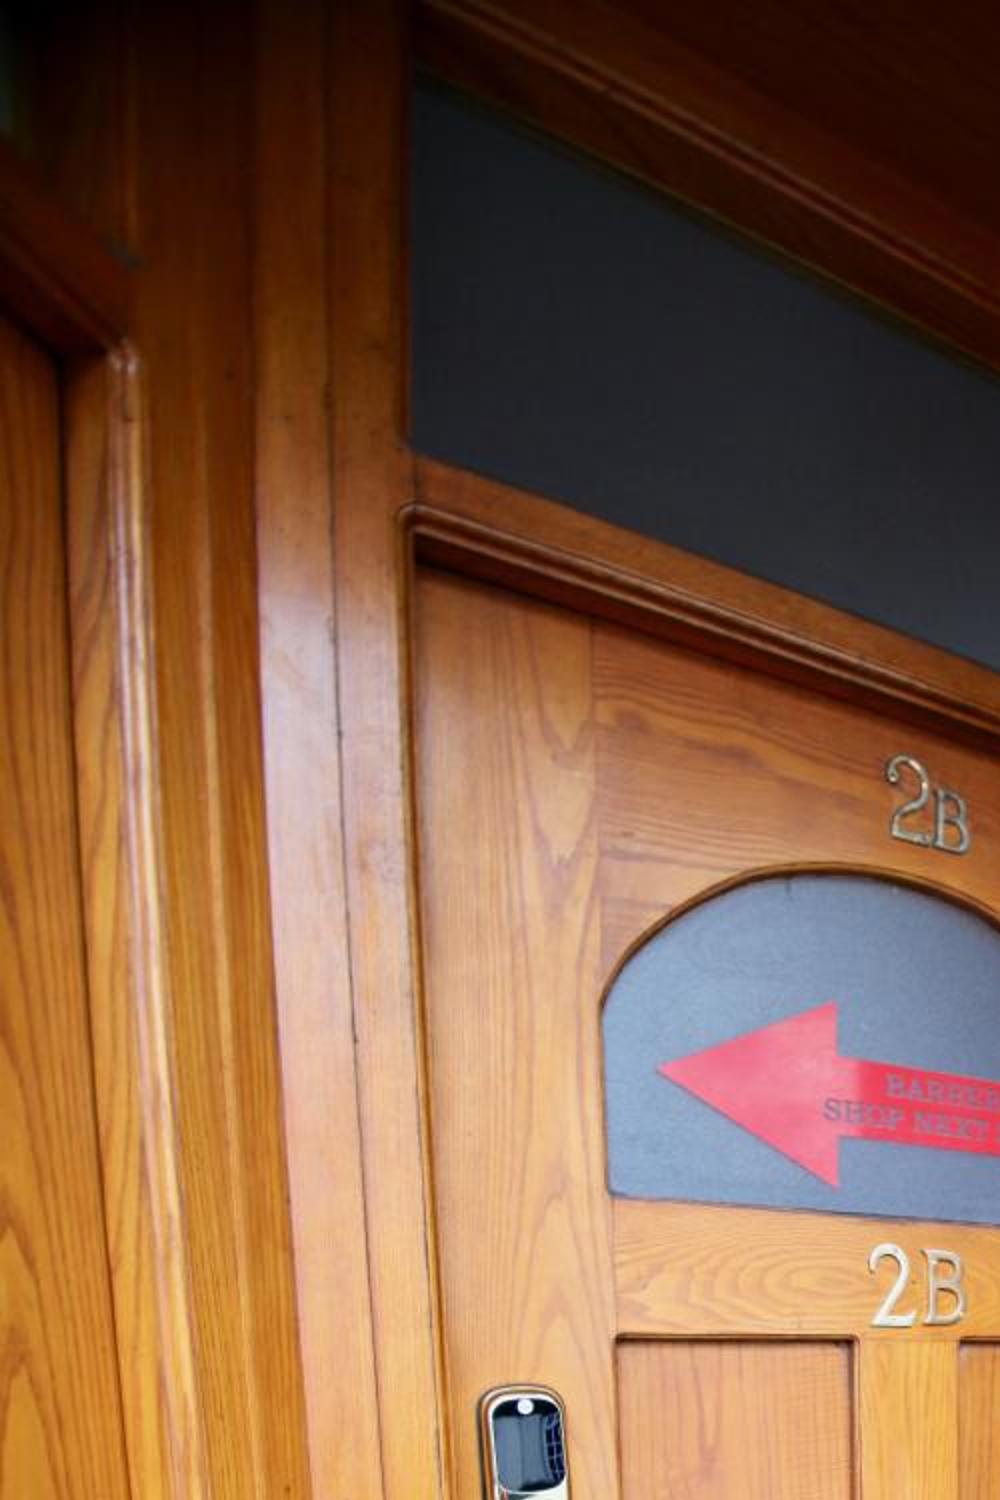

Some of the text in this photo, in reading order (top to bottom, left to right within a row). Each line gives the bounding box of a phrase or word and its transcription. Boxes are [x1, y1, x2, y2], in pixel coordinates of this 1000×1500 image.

[887, 755, 969, 853] 2B
[823, 1097, 904, 1129] SHOP
[913, 1108, 990, 1142] NEXT
[869, 1242, 967, 1327] 2B
